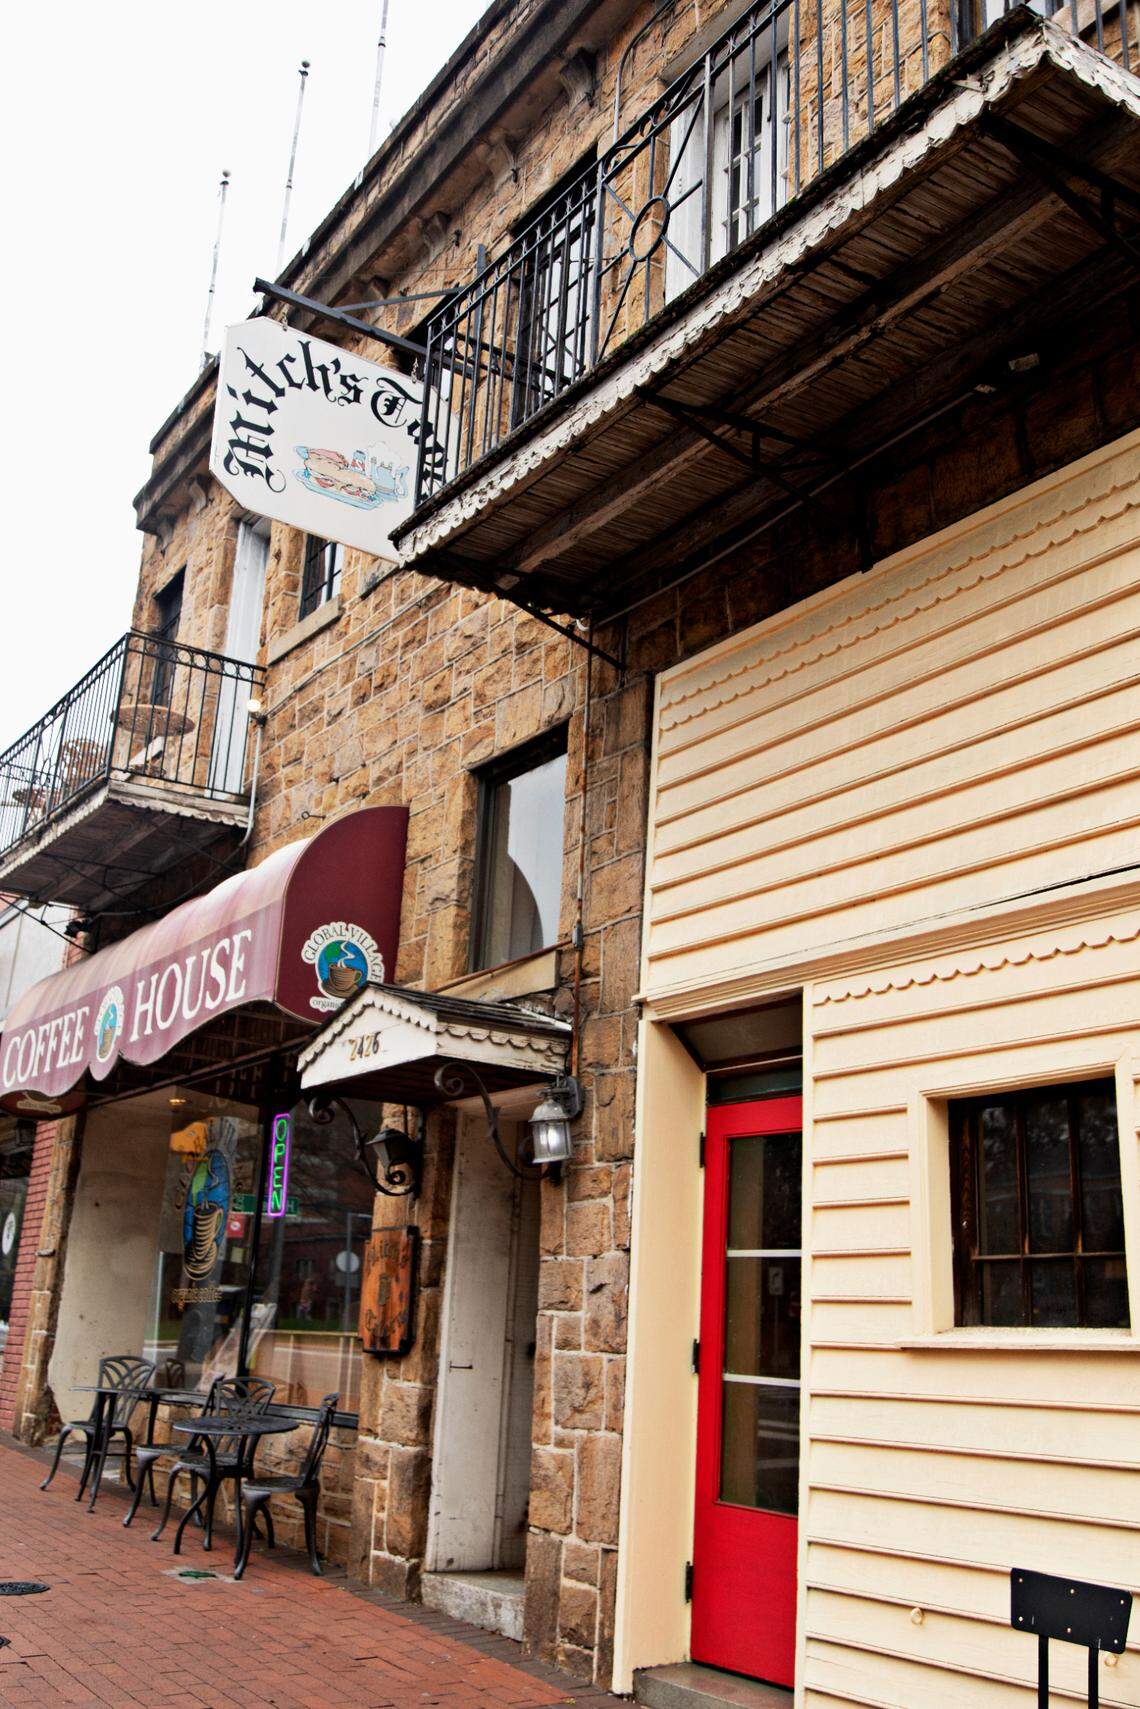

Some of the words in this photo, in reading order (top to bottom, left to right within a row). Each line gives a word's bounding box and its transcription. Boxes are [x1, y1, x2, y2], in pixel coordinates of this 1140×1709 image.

[223, 340, 369, 494] Mitch's
[3, 1005, 91, 1089] COFFEE
[129, 929, 253, 1043] HOUSE
[303, 924, 347, 962] GLOBAL
[349, 926, 383, 980] VILLAGE
[271, 1118, 288, 1211] OPEN
